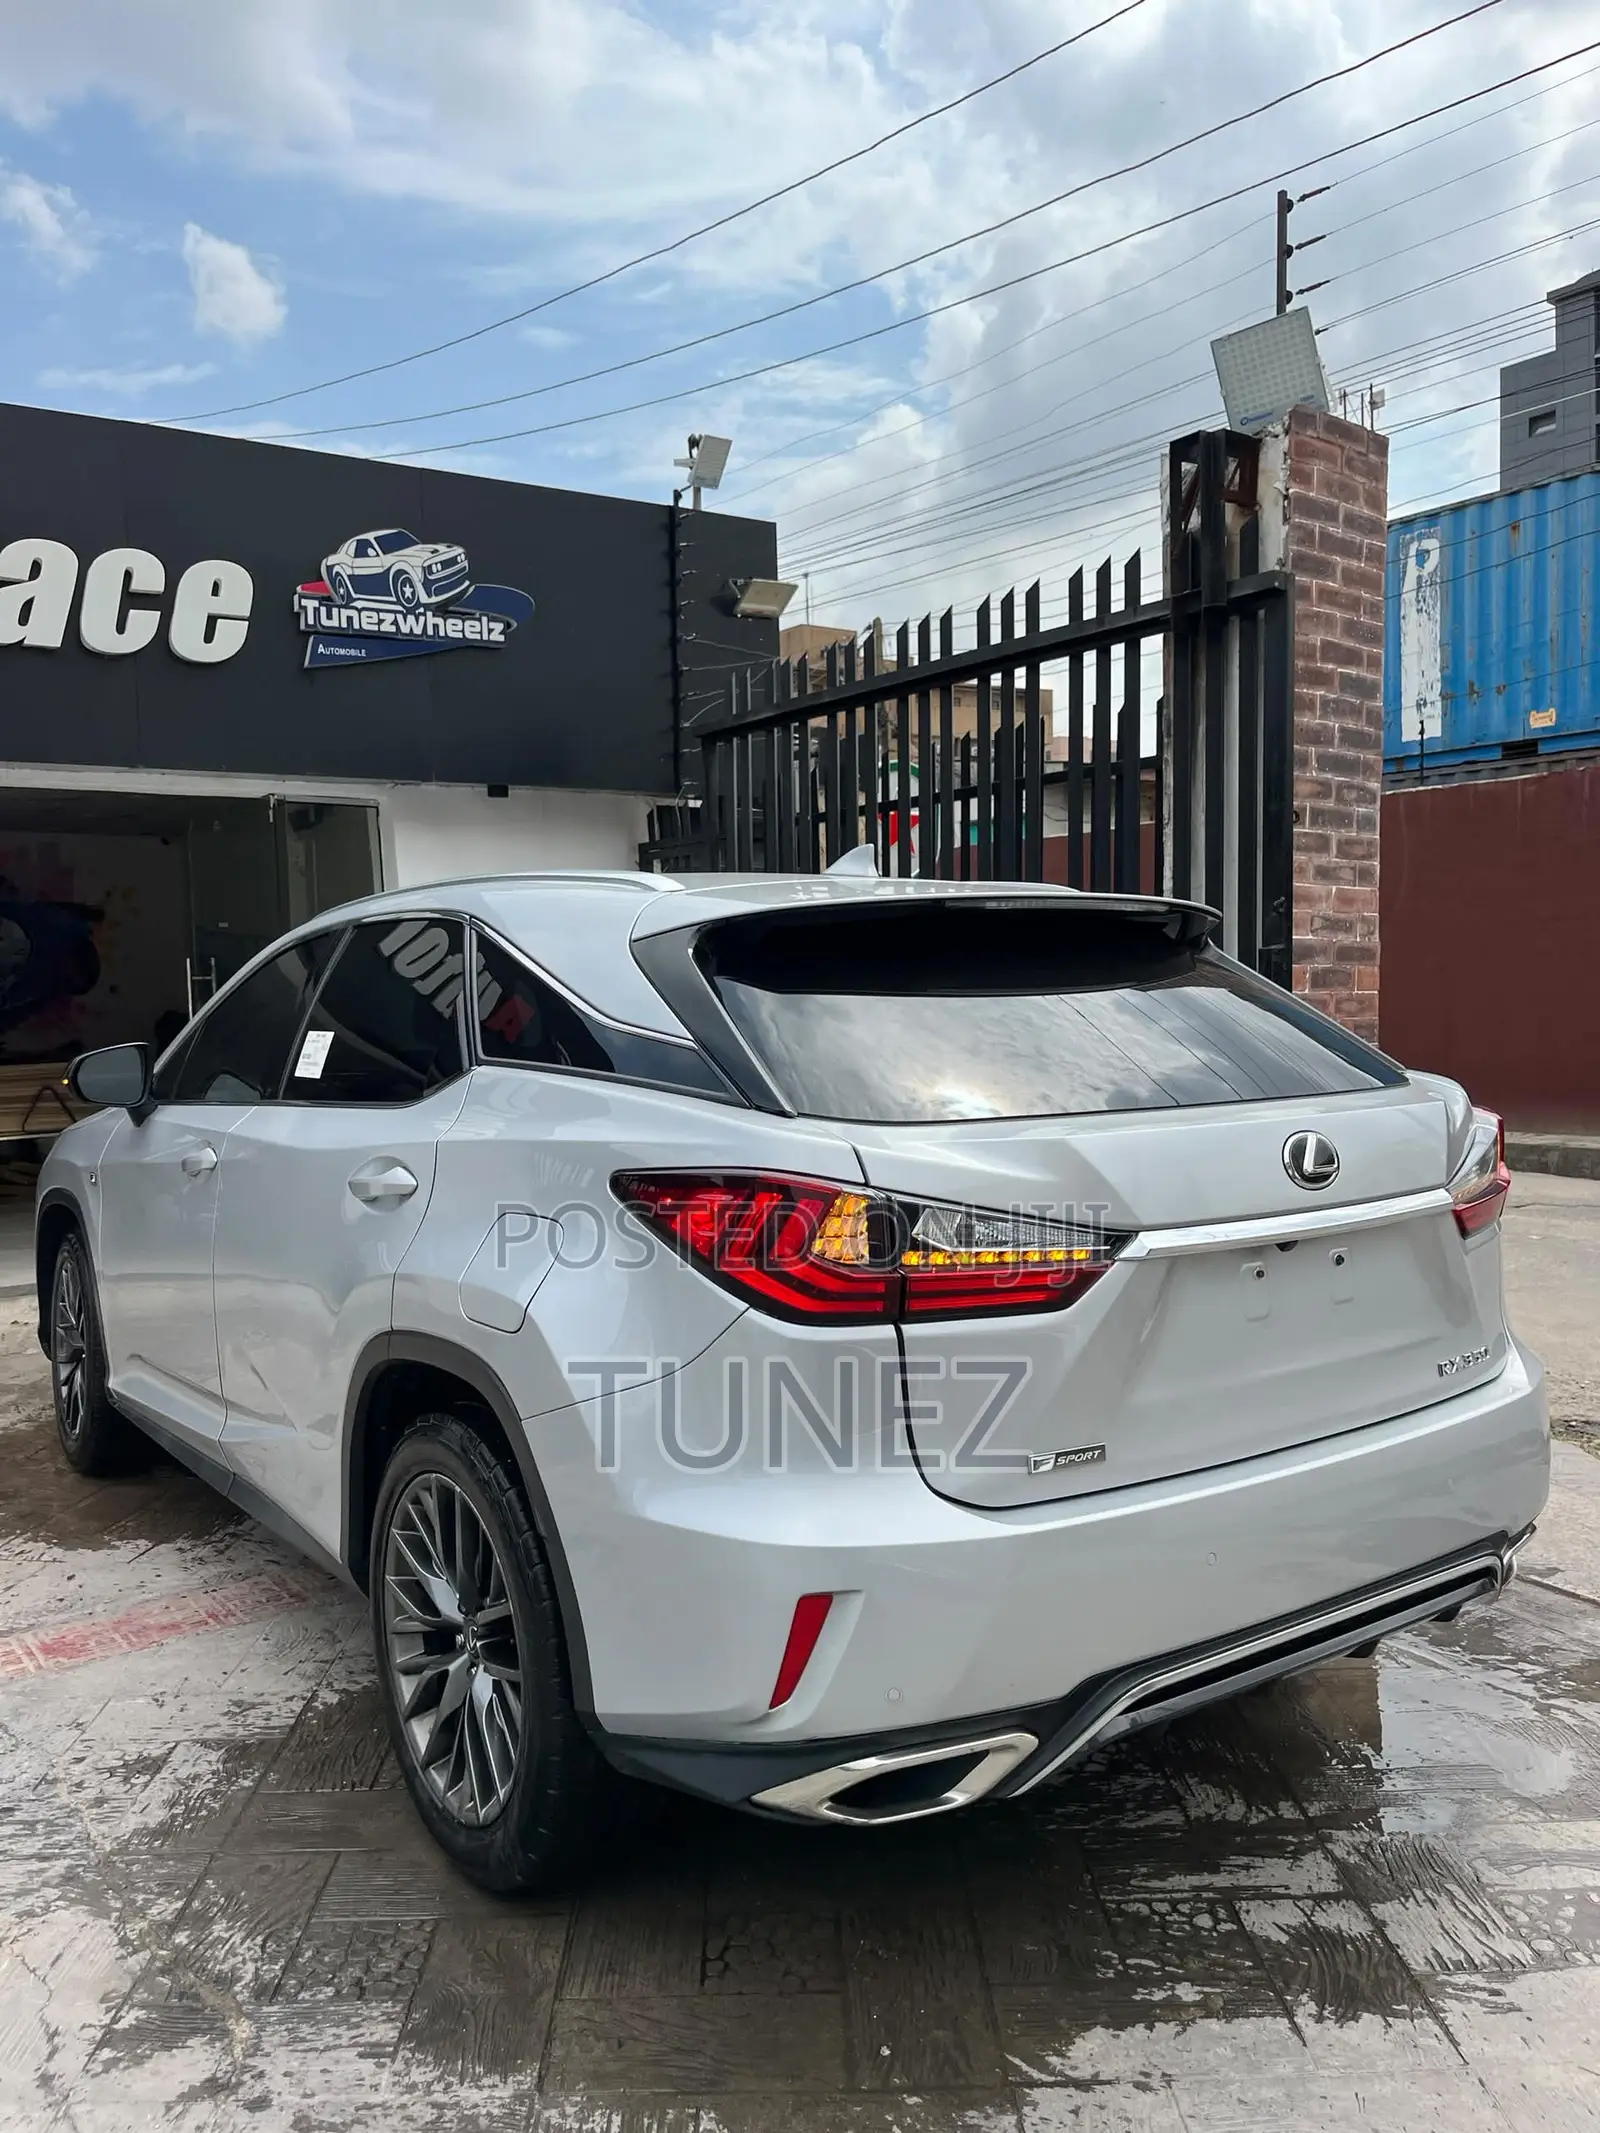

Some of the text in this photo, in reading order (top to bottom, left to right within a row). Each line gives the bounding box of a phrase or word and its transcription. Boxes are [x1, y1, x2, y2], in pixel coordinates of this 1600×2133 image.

[300, 598, 506, 642] Tunezwheelz
[317, 643, 367, 657] AUTOMOBILE
[1437, 1357, 1460, 1378] RX
[1055, 1450, 1102, 1466] SPORT
